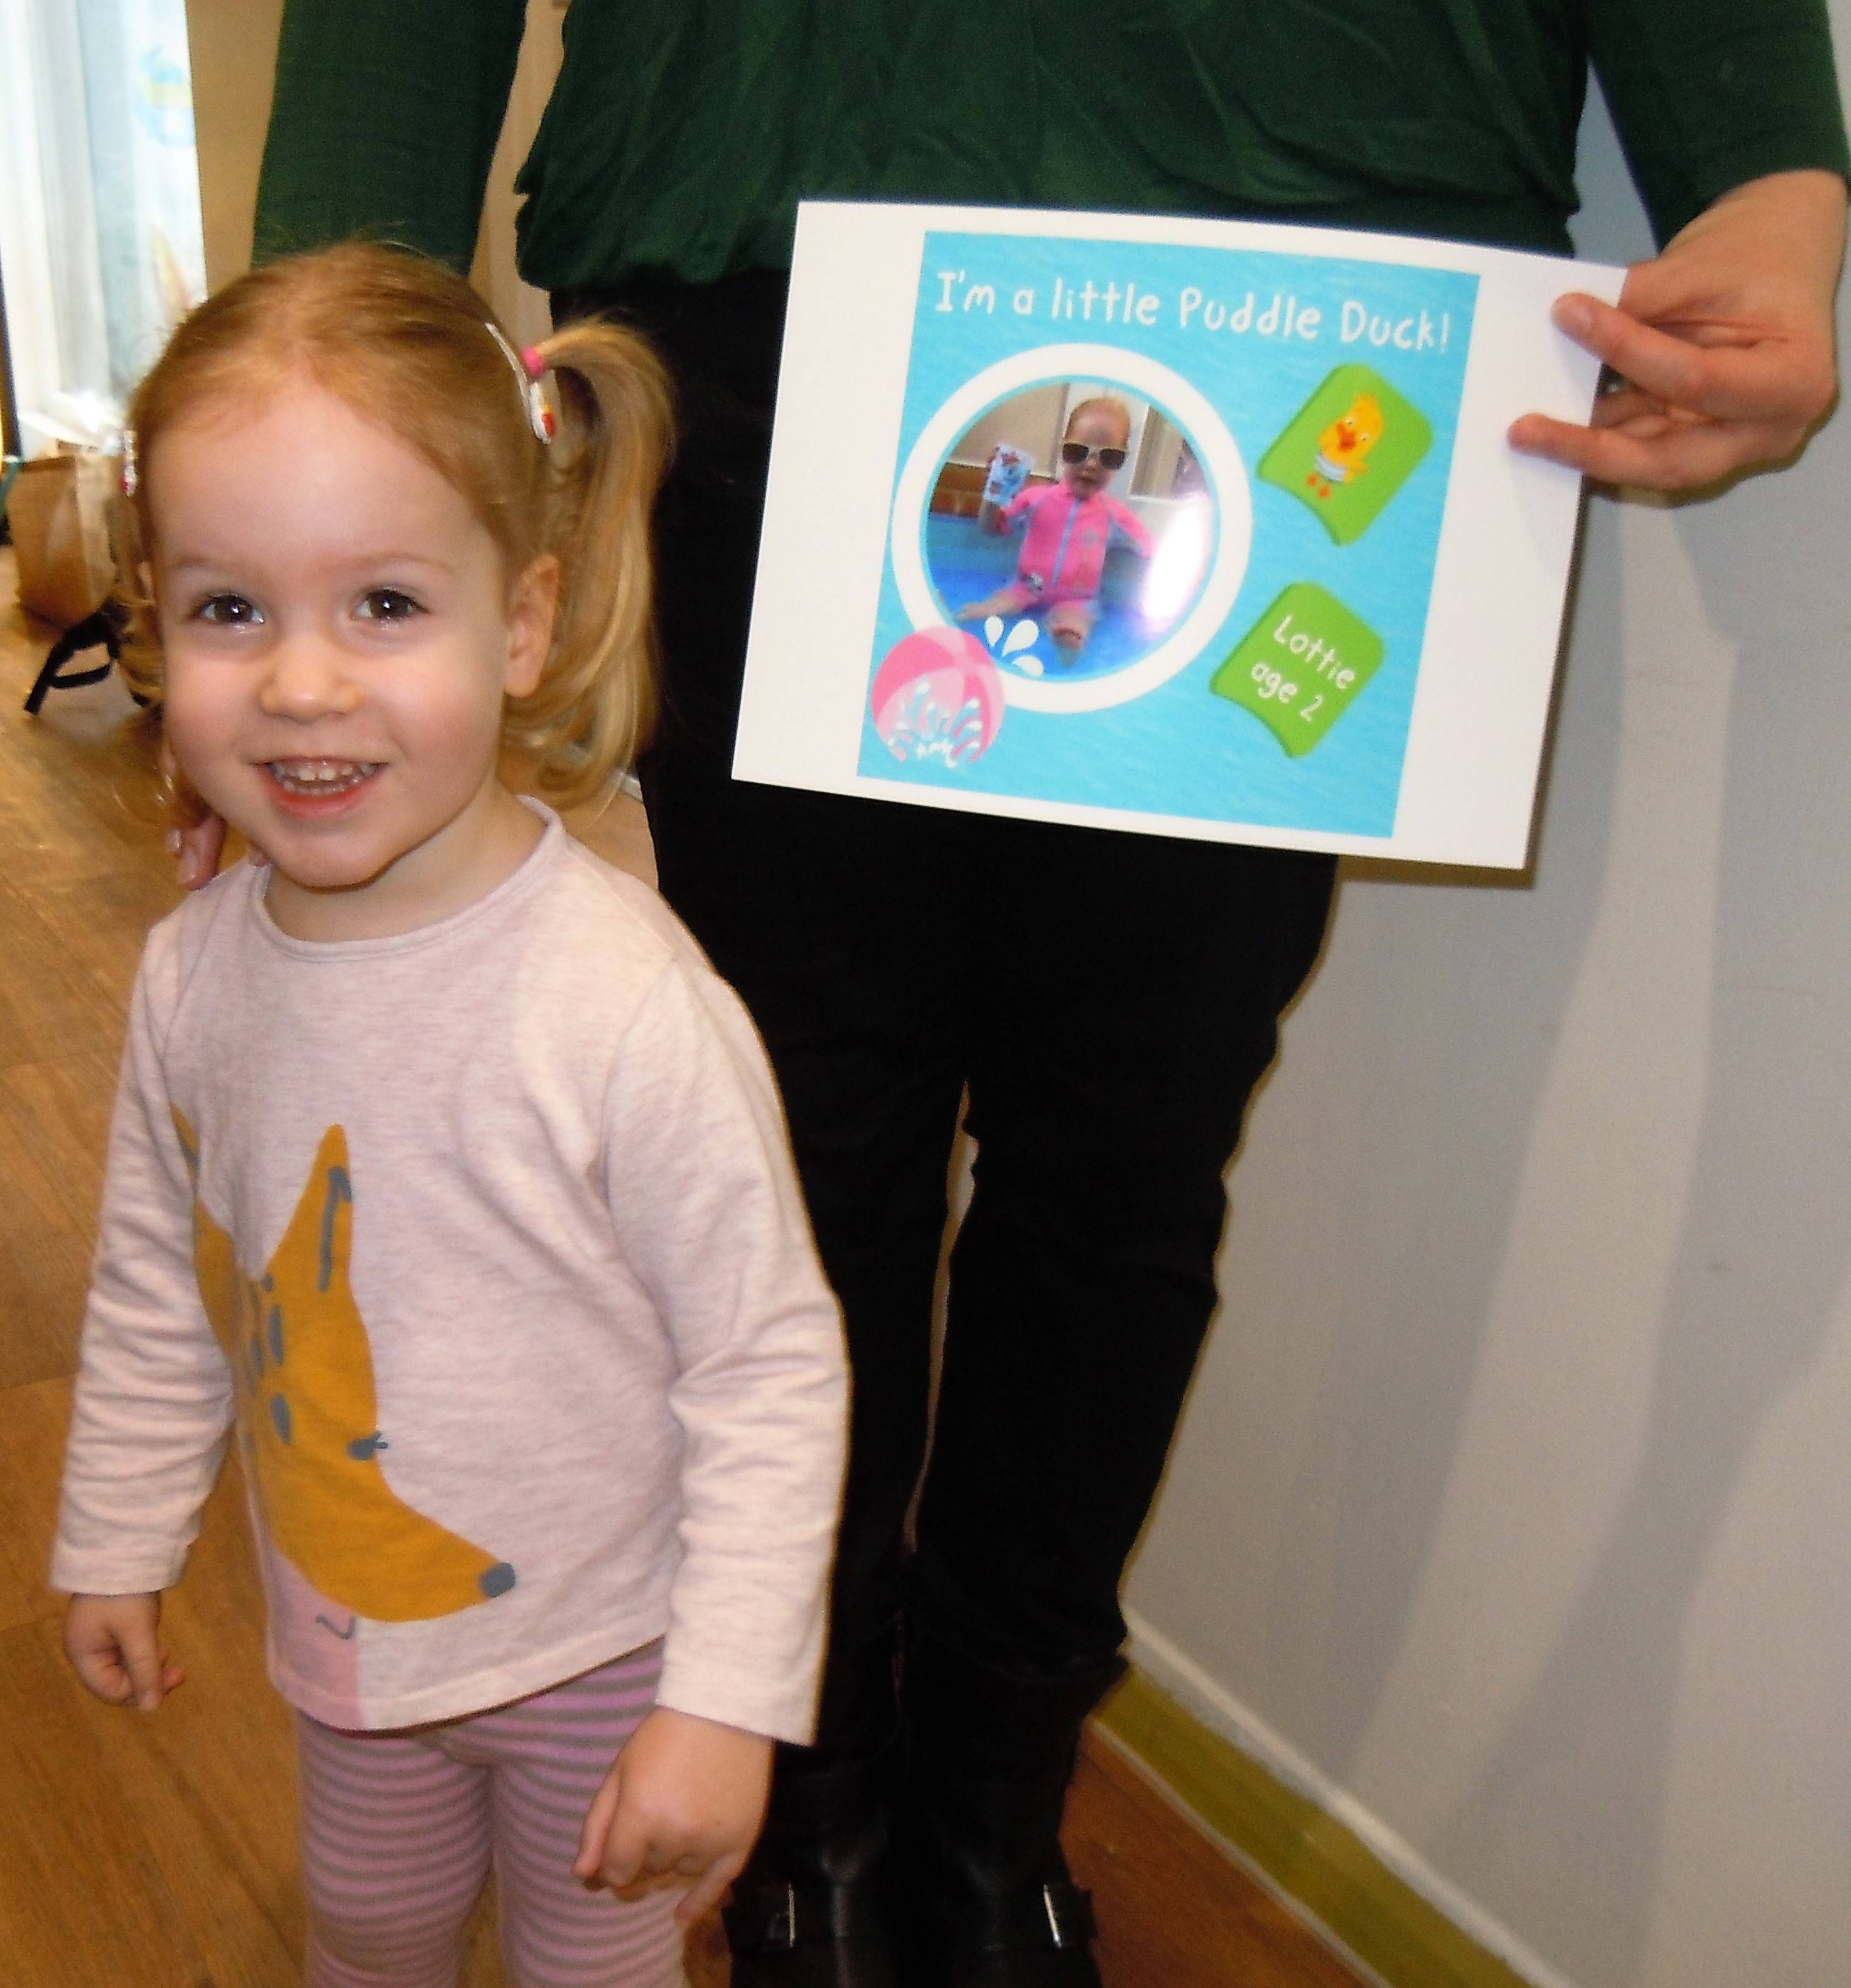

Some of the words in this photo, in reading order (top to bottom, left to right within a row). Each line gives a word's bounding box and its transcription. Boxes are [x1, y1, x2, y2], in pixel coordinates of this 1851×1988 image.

[936, 271, 995, 313] I'm
[1013, 287, 1035, 314] a
[1052, 277, 1160, 326] little
[1180, 286, 1320, 339] Puddle
[1340, 299, 1451, 352] Duck!
[1273, 615, 1355, 689] Lottie
[1251, 662, 1298, 703] age
[1300, 694, 1323, 722] 2
